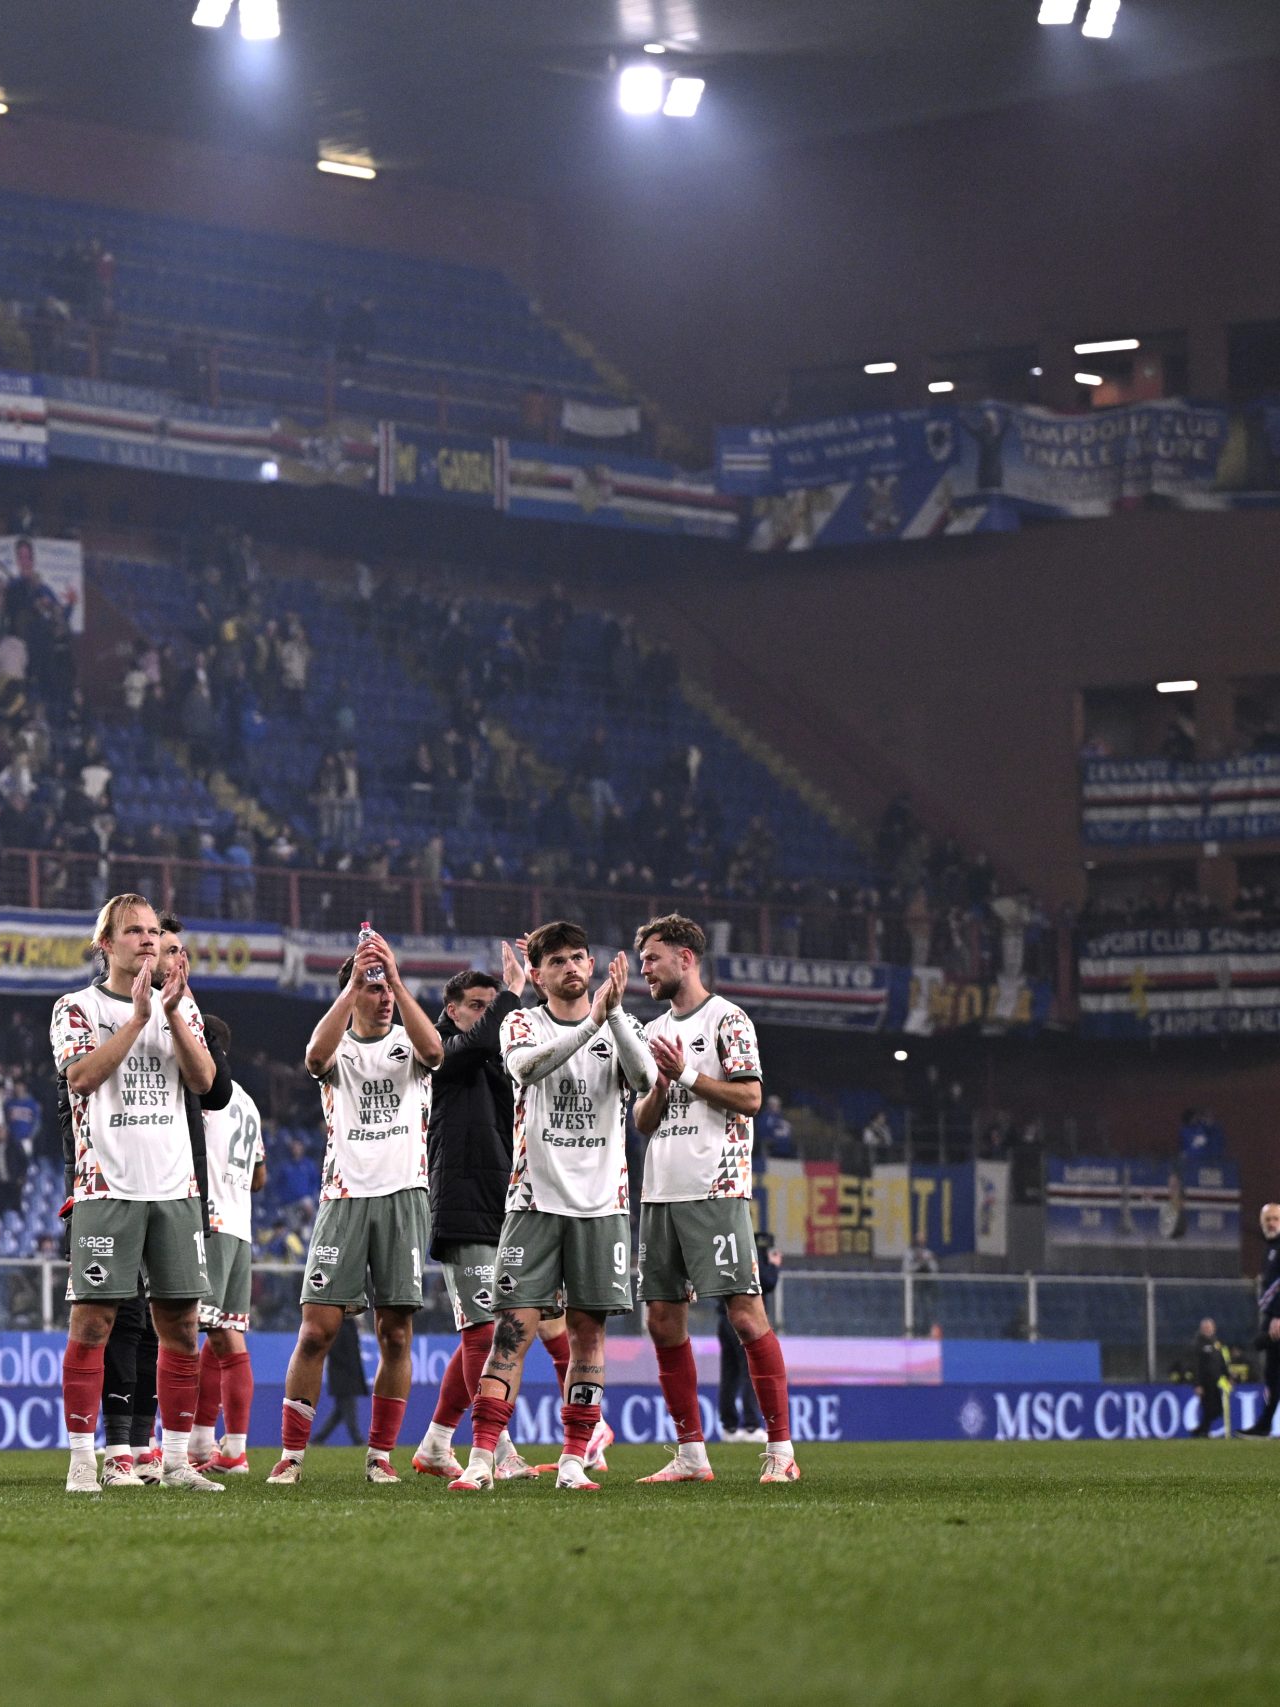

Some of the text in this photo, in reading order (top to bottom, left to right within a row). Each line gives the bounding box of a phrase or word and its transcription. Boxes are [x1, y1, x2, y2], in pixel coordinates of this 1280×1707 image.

[729, 957, 875, 988] LEVANTO
[127, 1056, 161, 1072] OLD
[123, 1073, 167, 1089] WILD
[362, 1078, 394, 1095] OLD
[559, 1079, 587, 1095] OLD
[121, 1090, 169, 1106] WEST
[359, 1094, 400, 1109] WILD
[553, 1095, 593, 1112] WILD
[549, 1112, 596, 1129] WEST
[228, 1103, 257, 1175] 28
[542, 1127, 606, 1148] Bisaten
[613, 1241, 627, 1275] 9
[713, 1233, 739, 1266] 21
[995, 1391, 1085, 1441] MSC
